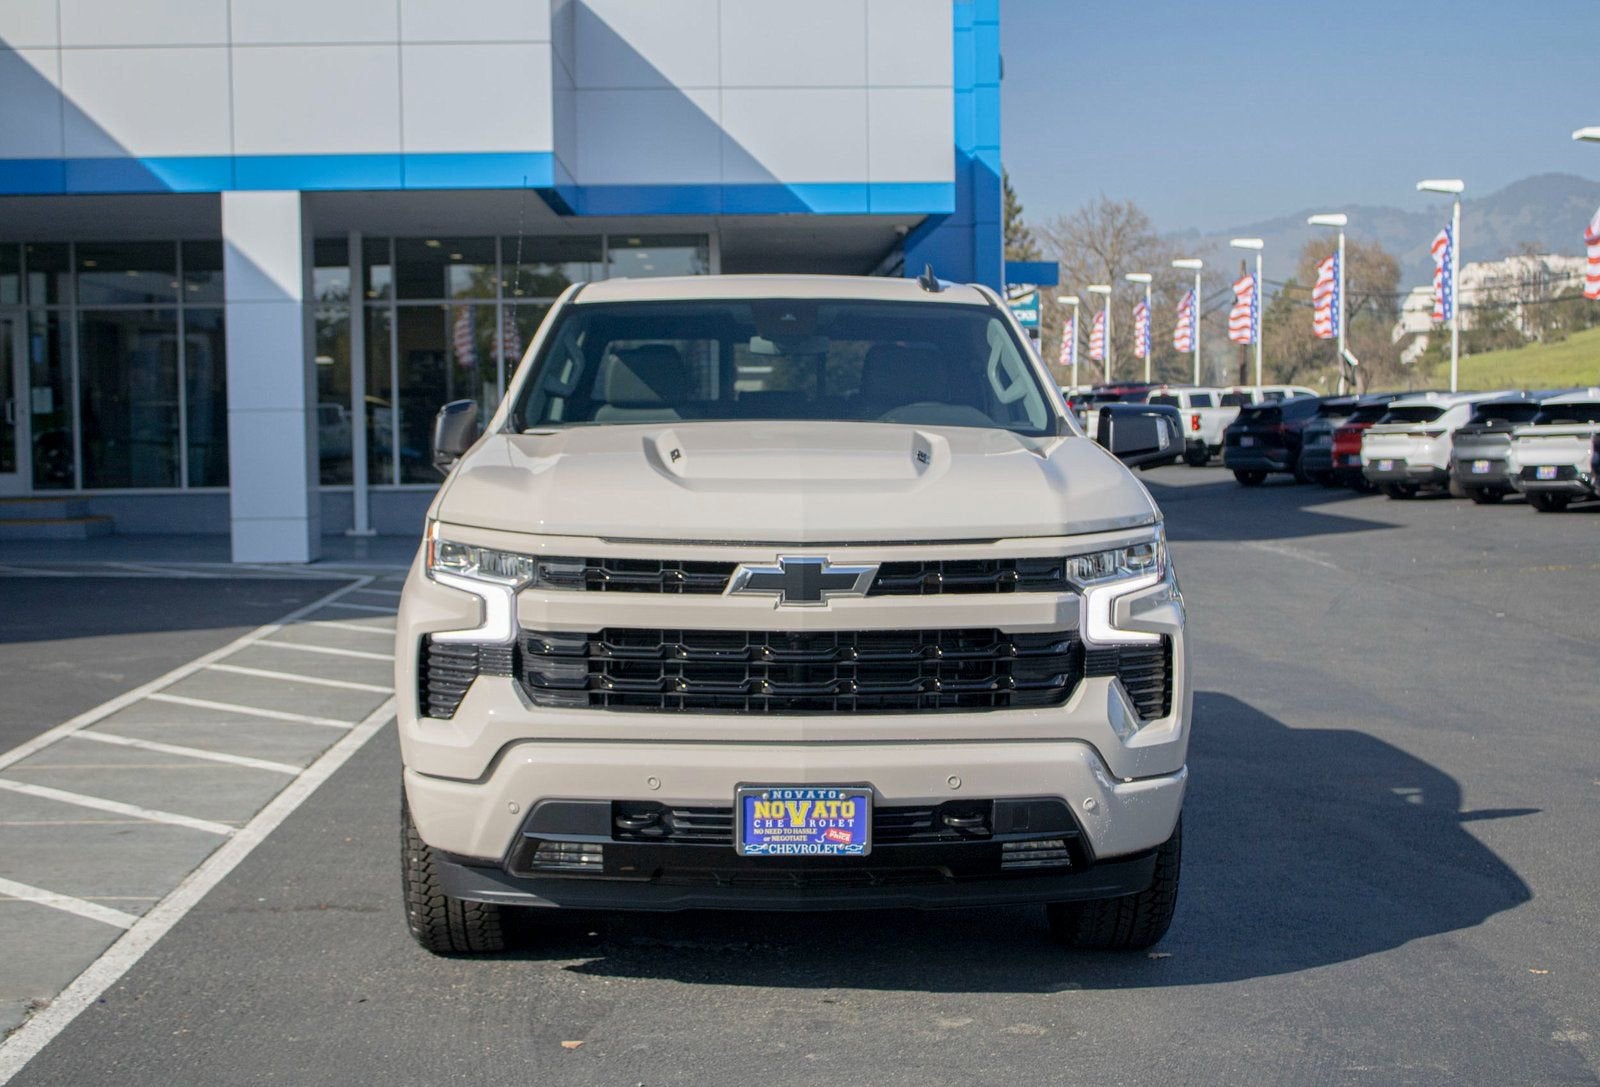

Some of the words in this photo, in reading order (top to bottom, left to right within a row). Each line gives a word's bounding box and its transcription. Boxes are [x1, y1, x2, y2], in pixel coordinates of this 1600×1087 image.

[773, 790, 836, 799] NOVATO
[753, 800, 855, 827] NOVATO
[768, 844, 838, 854] CHEVROLET
